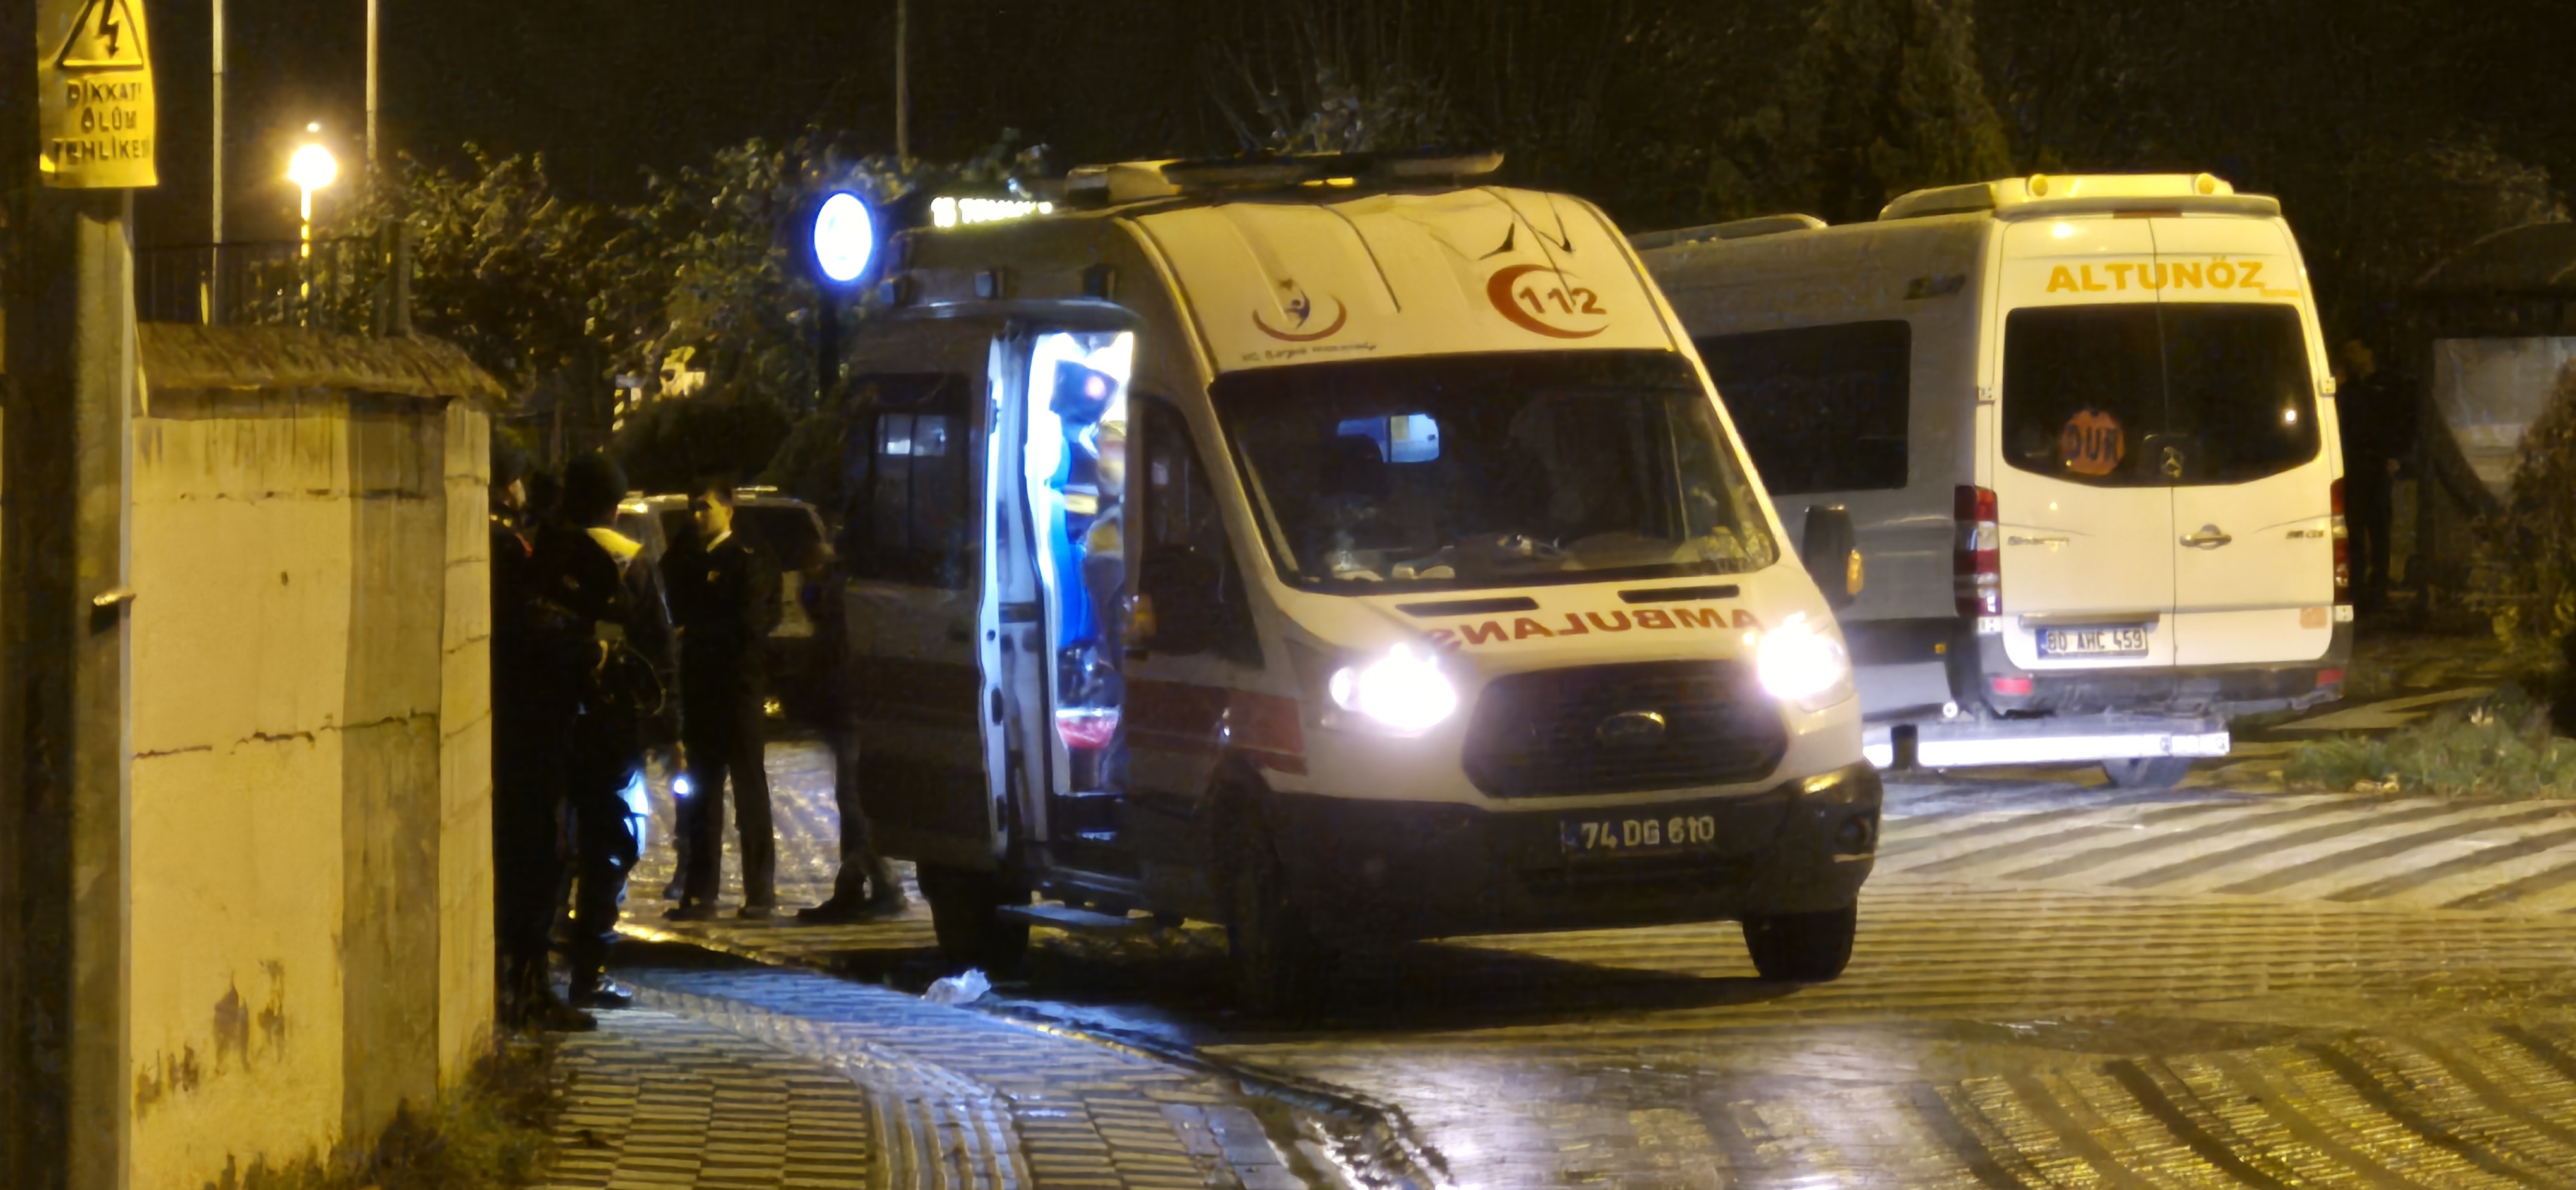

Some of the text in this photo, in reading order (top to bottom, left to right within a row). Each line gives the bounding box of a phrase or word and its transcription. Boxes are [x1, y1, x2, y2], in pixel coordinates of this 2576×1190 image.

[81, 106, 137, 134] ÖLÜM
[2046, 255, 2265, 292] ALTUNÖZ
[1518, 286, 1607, 315] 112
[2113, 629, 2142, 650] 459
[1581, 822, 1618, 850] 74
[1667, 815, 1715, 843] 610
